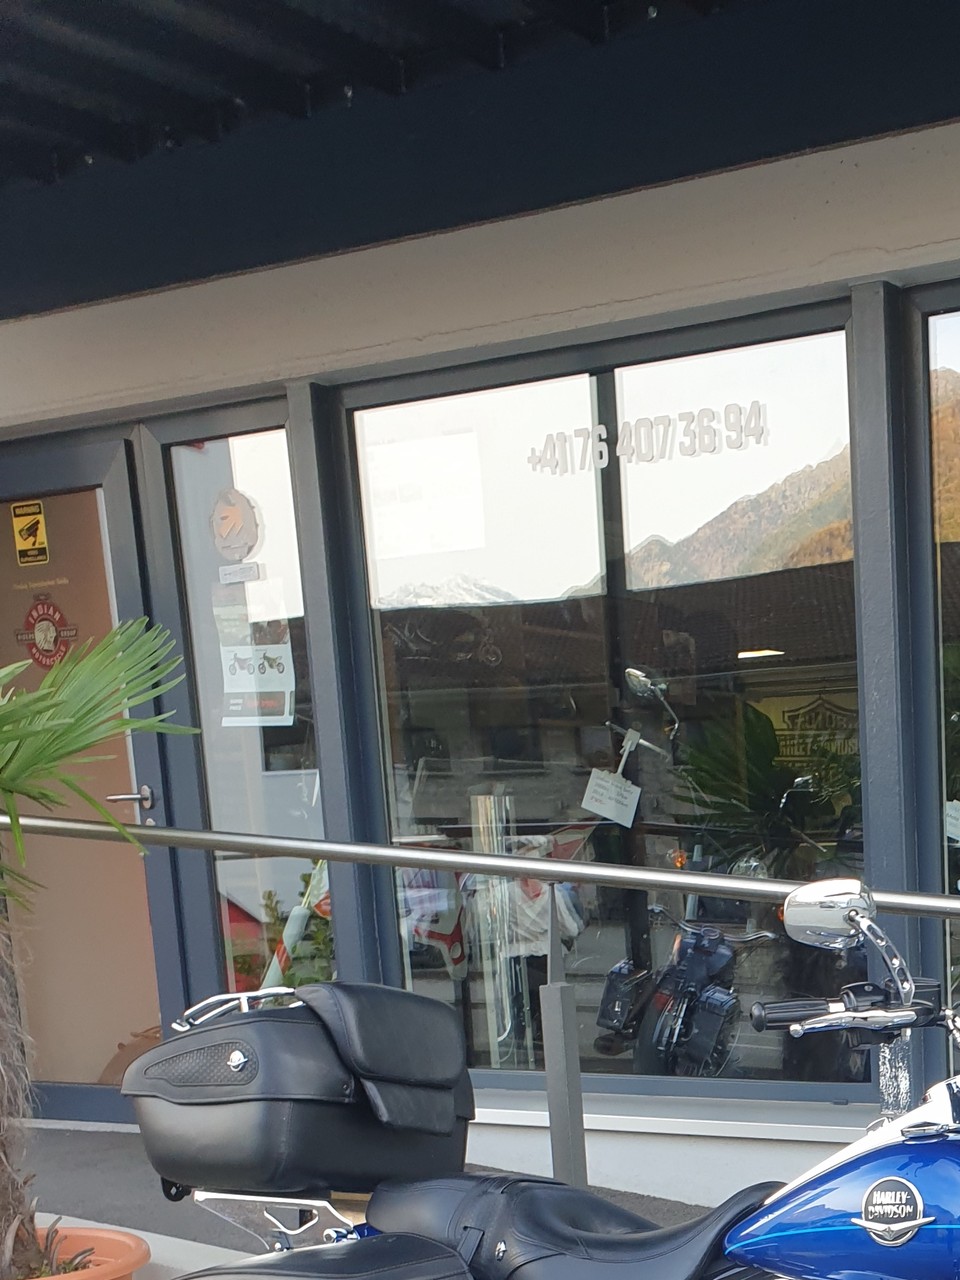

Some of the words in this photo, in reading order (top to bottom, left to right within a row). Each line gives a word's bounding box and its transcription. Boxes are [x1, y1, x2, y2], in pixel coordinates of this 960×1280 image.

[574, 423, 610, 470] 76
[616, 415, 672, 463] 407
[678, 407, 717, 457] 36
[724, 400, 765, 449] 94
[28, 604, 61, 624] INDIAN
[872, 1190, 911, 1205] HARLEY-
[868, 1205, 914, 1220] DAVIDSON
